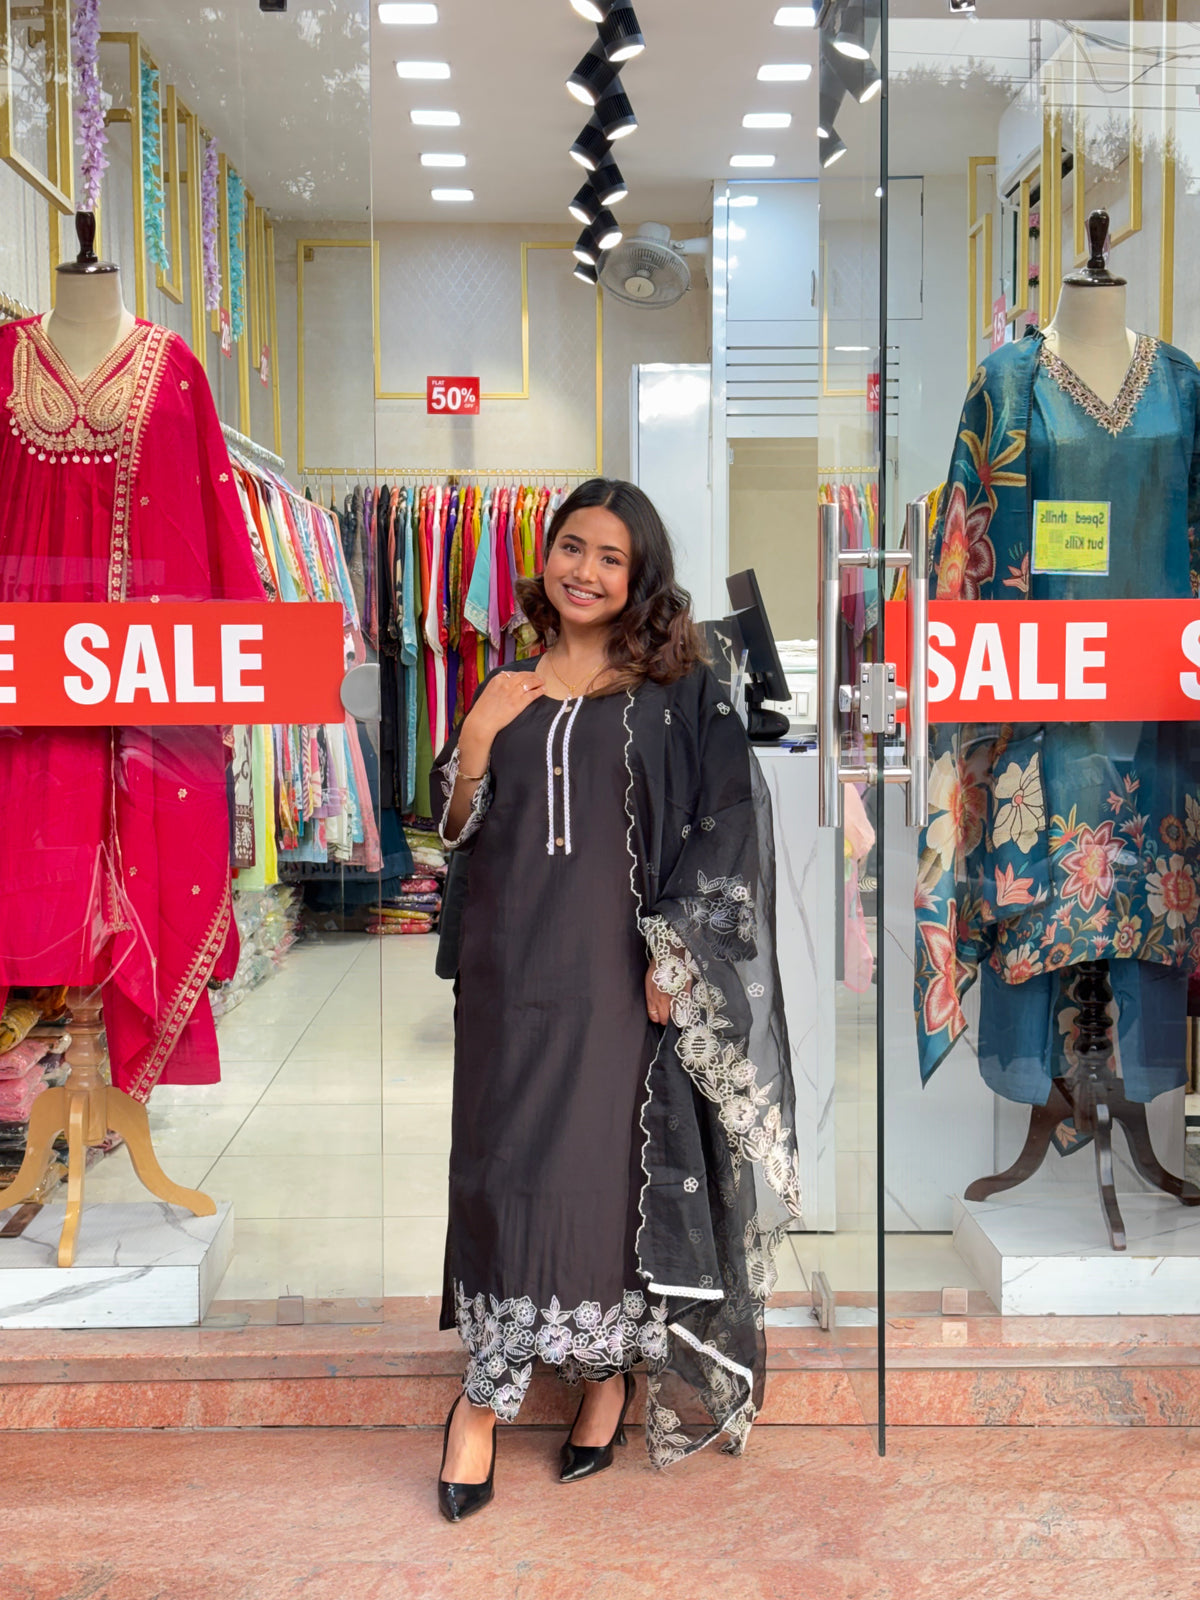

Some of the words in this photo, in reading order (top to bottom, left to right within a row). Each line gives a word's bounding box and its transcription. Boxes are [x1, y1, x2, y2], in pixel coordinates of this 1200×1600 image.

[431, 387, 476, 410] 50%
[63, 622, 265, 705] SALE
[927, 621, 1108, 702] SALE
